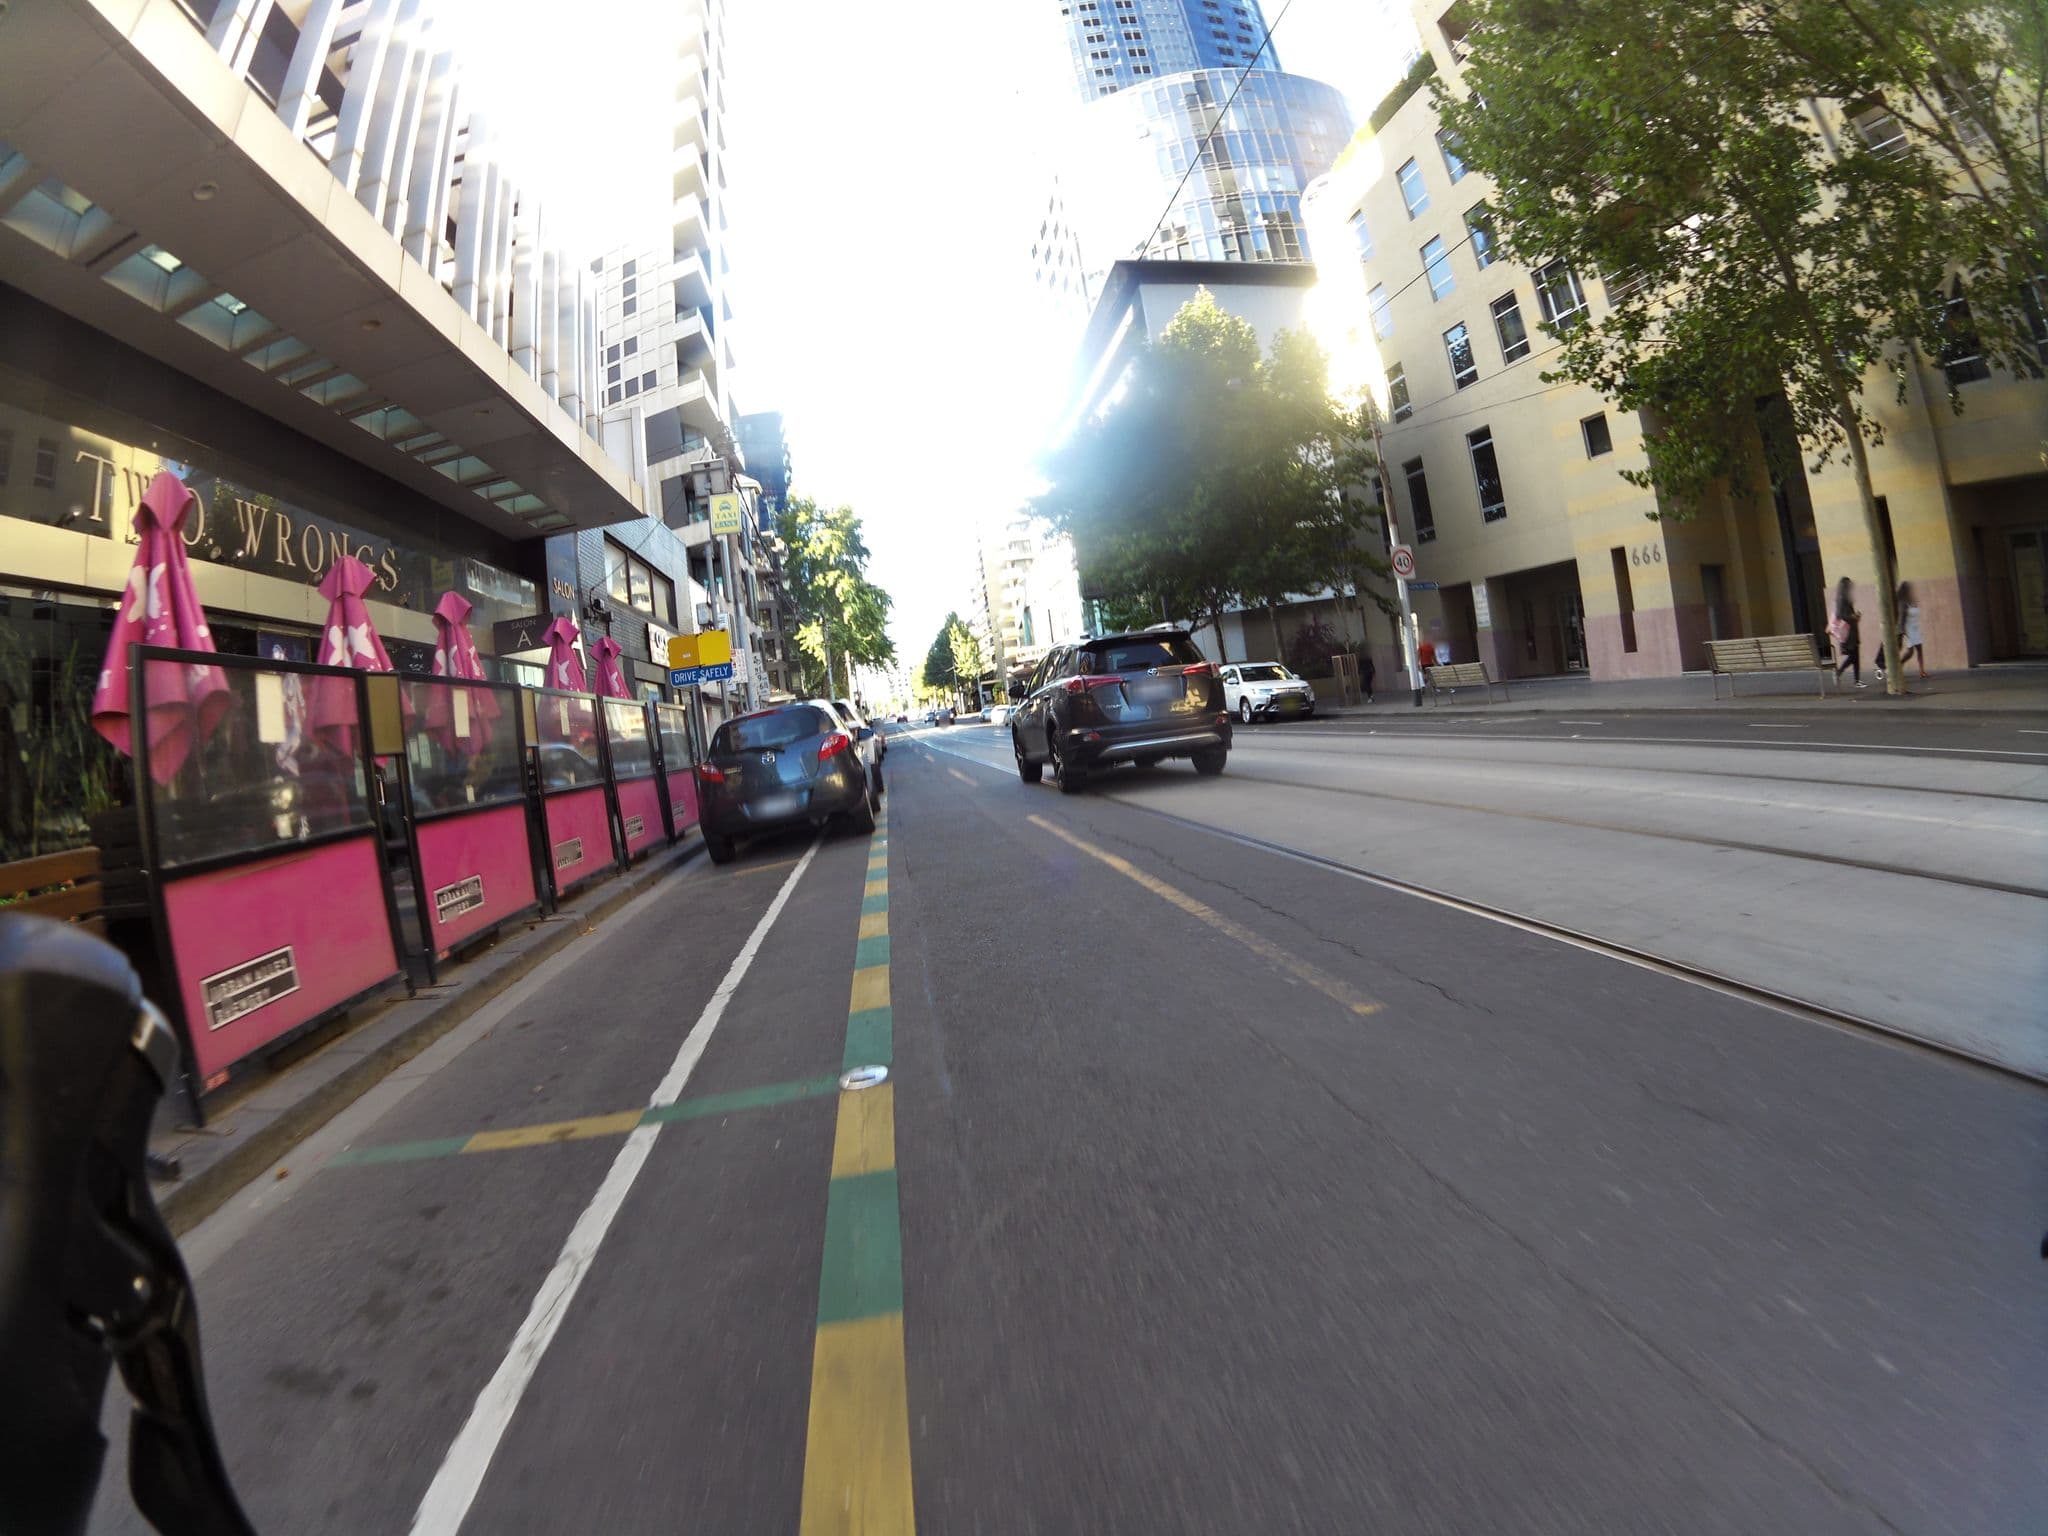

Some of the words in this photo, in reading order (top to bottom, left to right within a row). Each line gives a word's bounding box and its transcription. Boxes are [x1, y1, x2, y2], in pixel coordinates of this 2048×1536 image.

[1396, 555, 1410, 569] 40
[1632, 544, 1661, 567] 666
[553, 578, 575, 600] SALON
[511, 620, 537, 632] SALON
[517, 630, 532, 649] A
[673, 670, 697, 684] DRIVE
[698, 665, 729, 682] SAFELY
